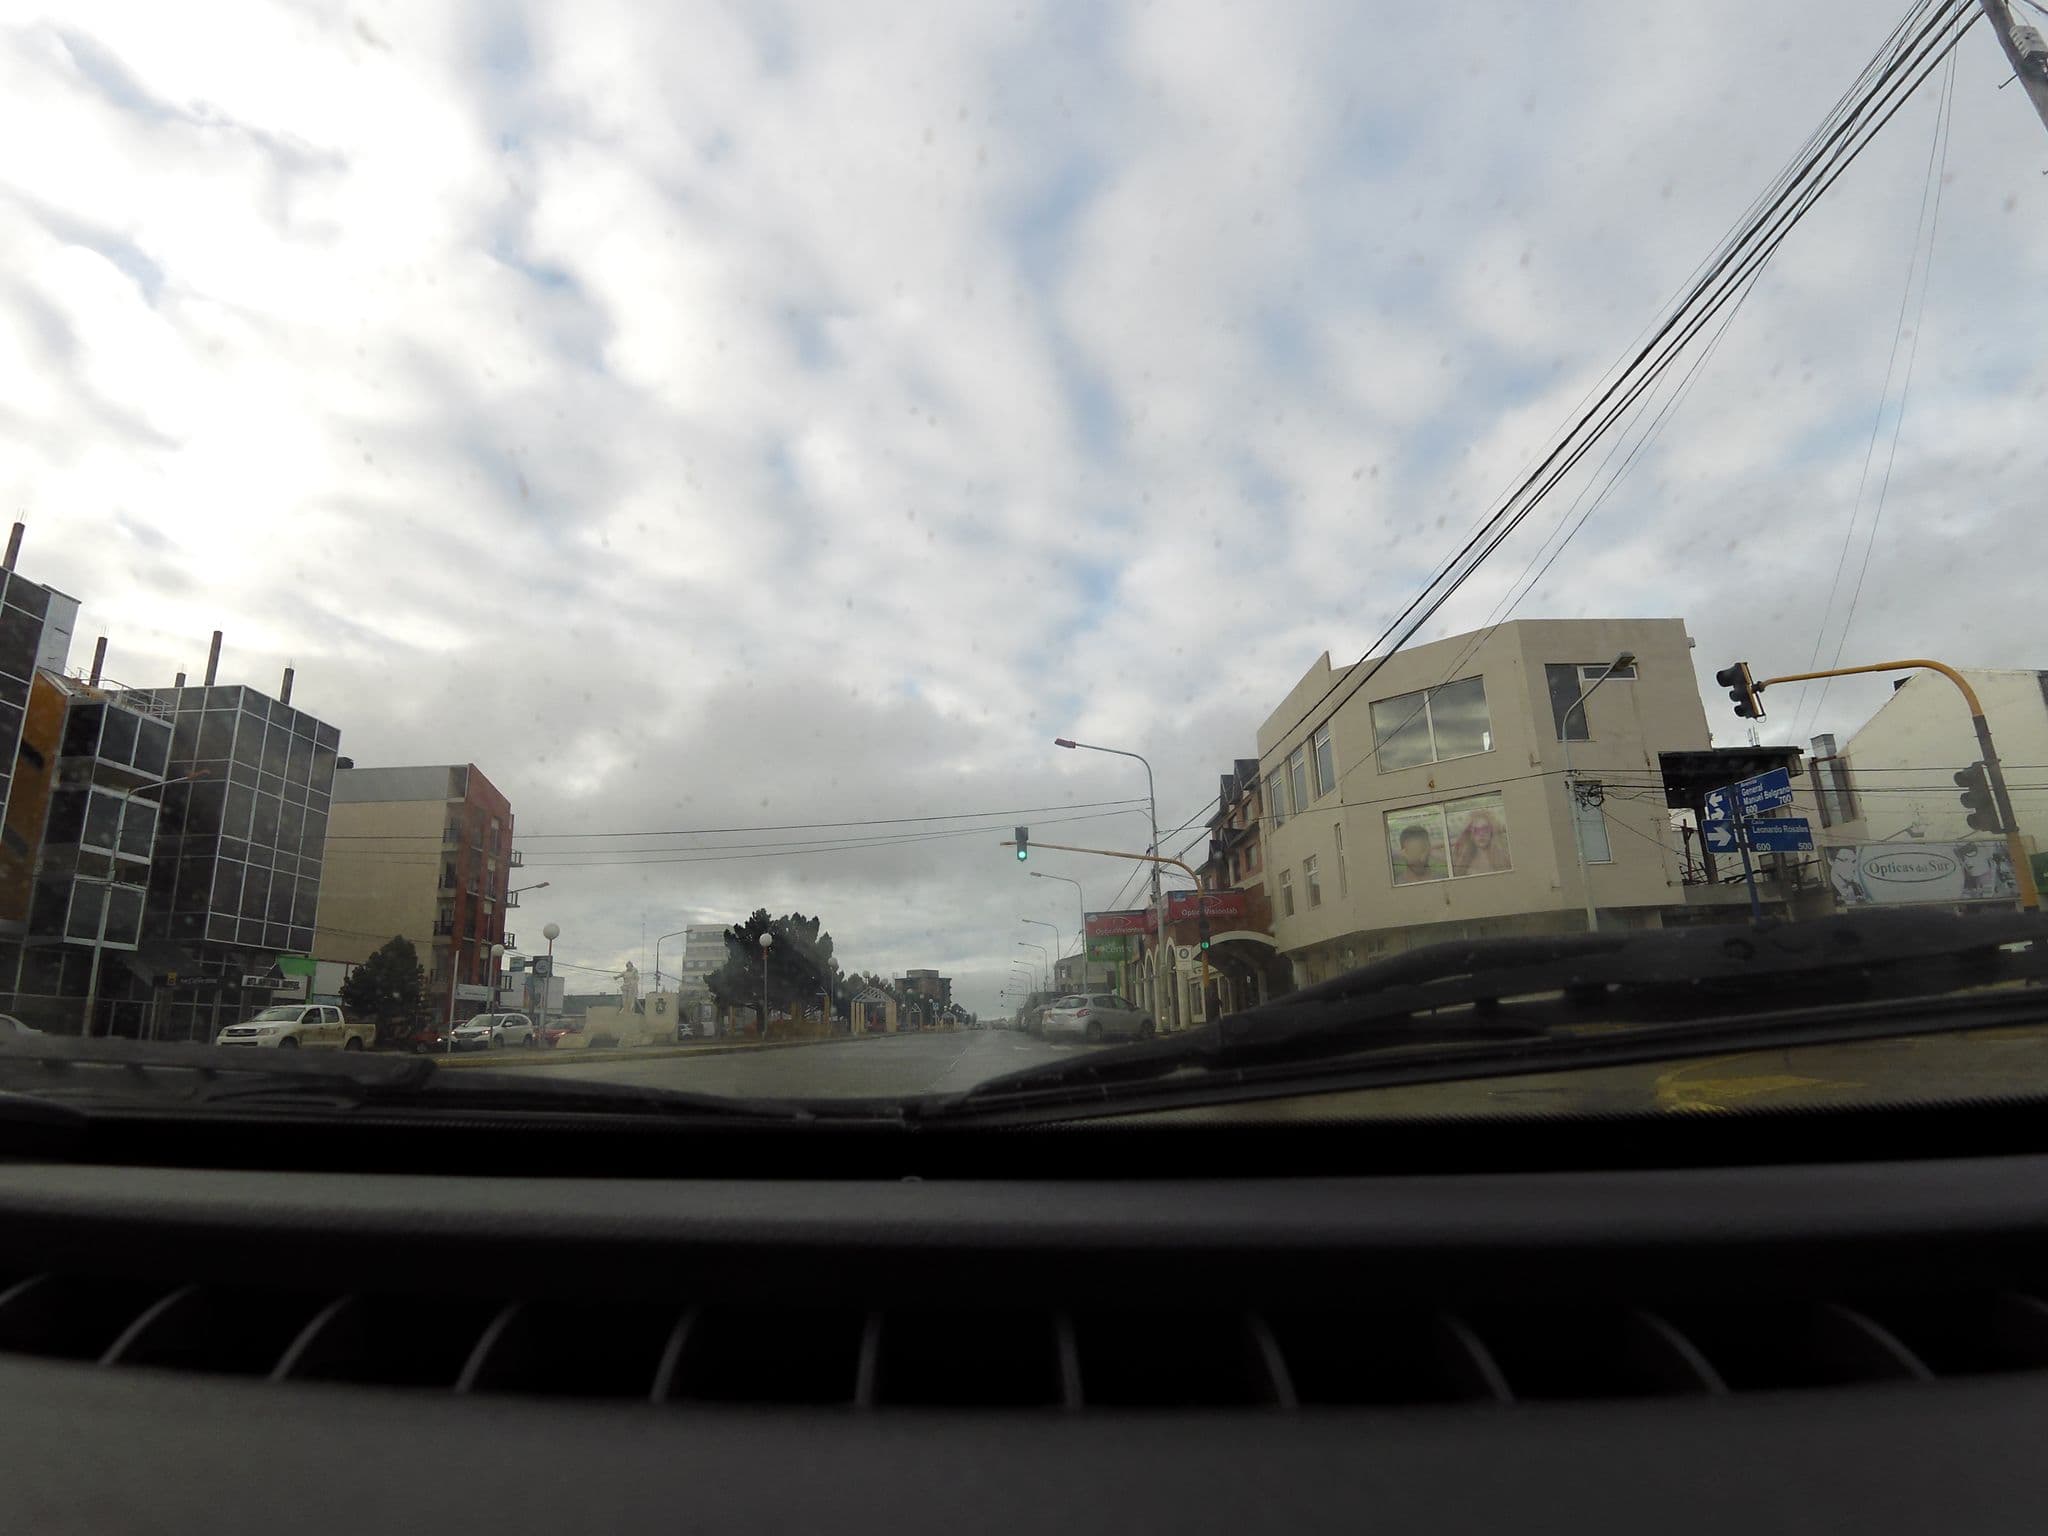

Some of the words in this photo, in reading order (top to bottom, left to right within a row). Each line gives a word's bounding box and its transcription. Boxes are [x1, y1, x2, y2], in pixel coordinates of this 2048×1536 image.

[1741, 783, 1763, 796] General
[1743, 793, 1764, 805] Manuel
[1764, 786, 1791, 800] Belgrano
[1746, 804, 1758, 814] 600
[1778, 794, 1792, 805] 700
[1753, 825, 1783, 834] Leonardo
[1783, 824, 1809, 833] Rosales
[1756, 843, 1771, 851] 600
[1798, 842, 1812, 850] 500
[1869, 861, 1914, 877] Opticas
[1928, 859, 1950, 872] Sur
